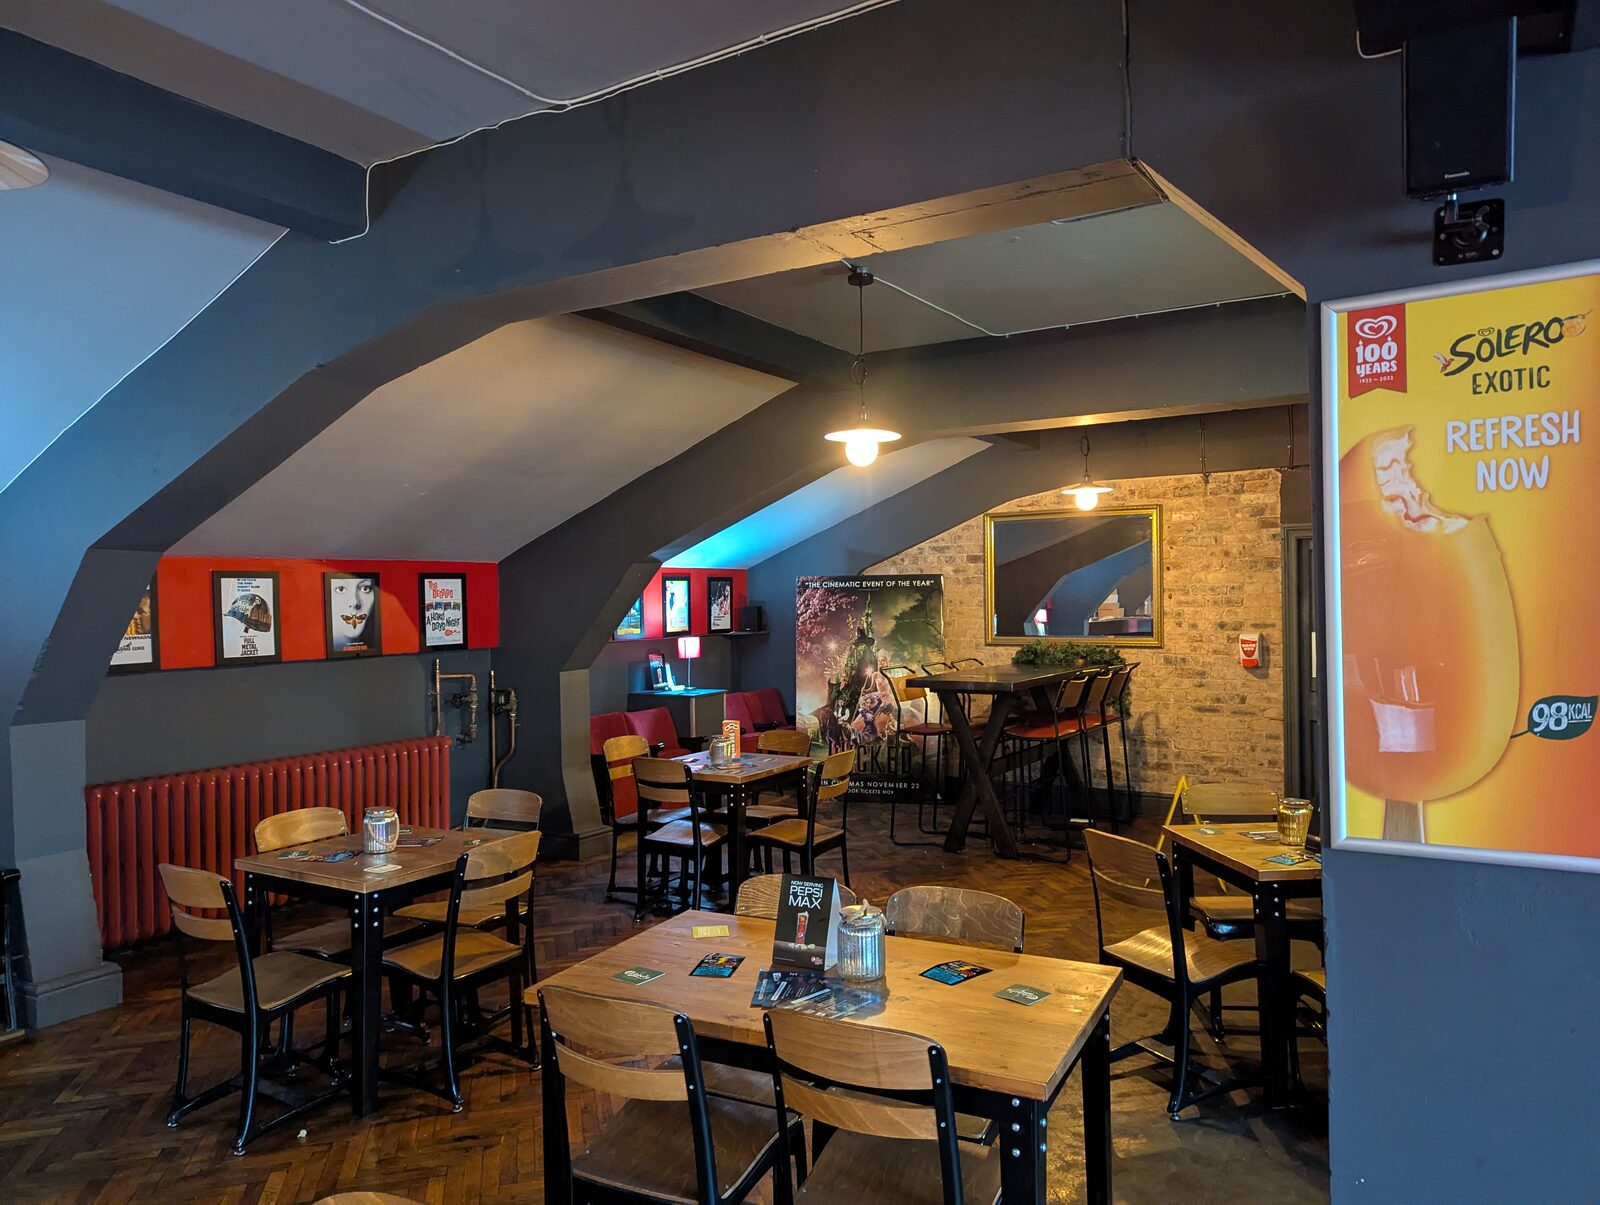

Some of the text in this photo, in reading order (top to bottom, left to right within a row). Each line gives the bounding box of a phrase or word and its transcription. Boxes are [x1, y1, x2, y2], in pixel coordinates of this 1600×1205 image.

[1355, 337, 1398, 364] 100
[1356, 360, 1398, 377] YEARS
[1472, 365, 1551, 395] EXOTIC
[1446, 409, 1581, 453] REFRESH
[1475, 454, 1550, 492] NOW
[1532, 702, 1593, 732] 98 KCAL
[788, 895, 822, 909] MAX
[789, 885, 824, 898] PEPSI
